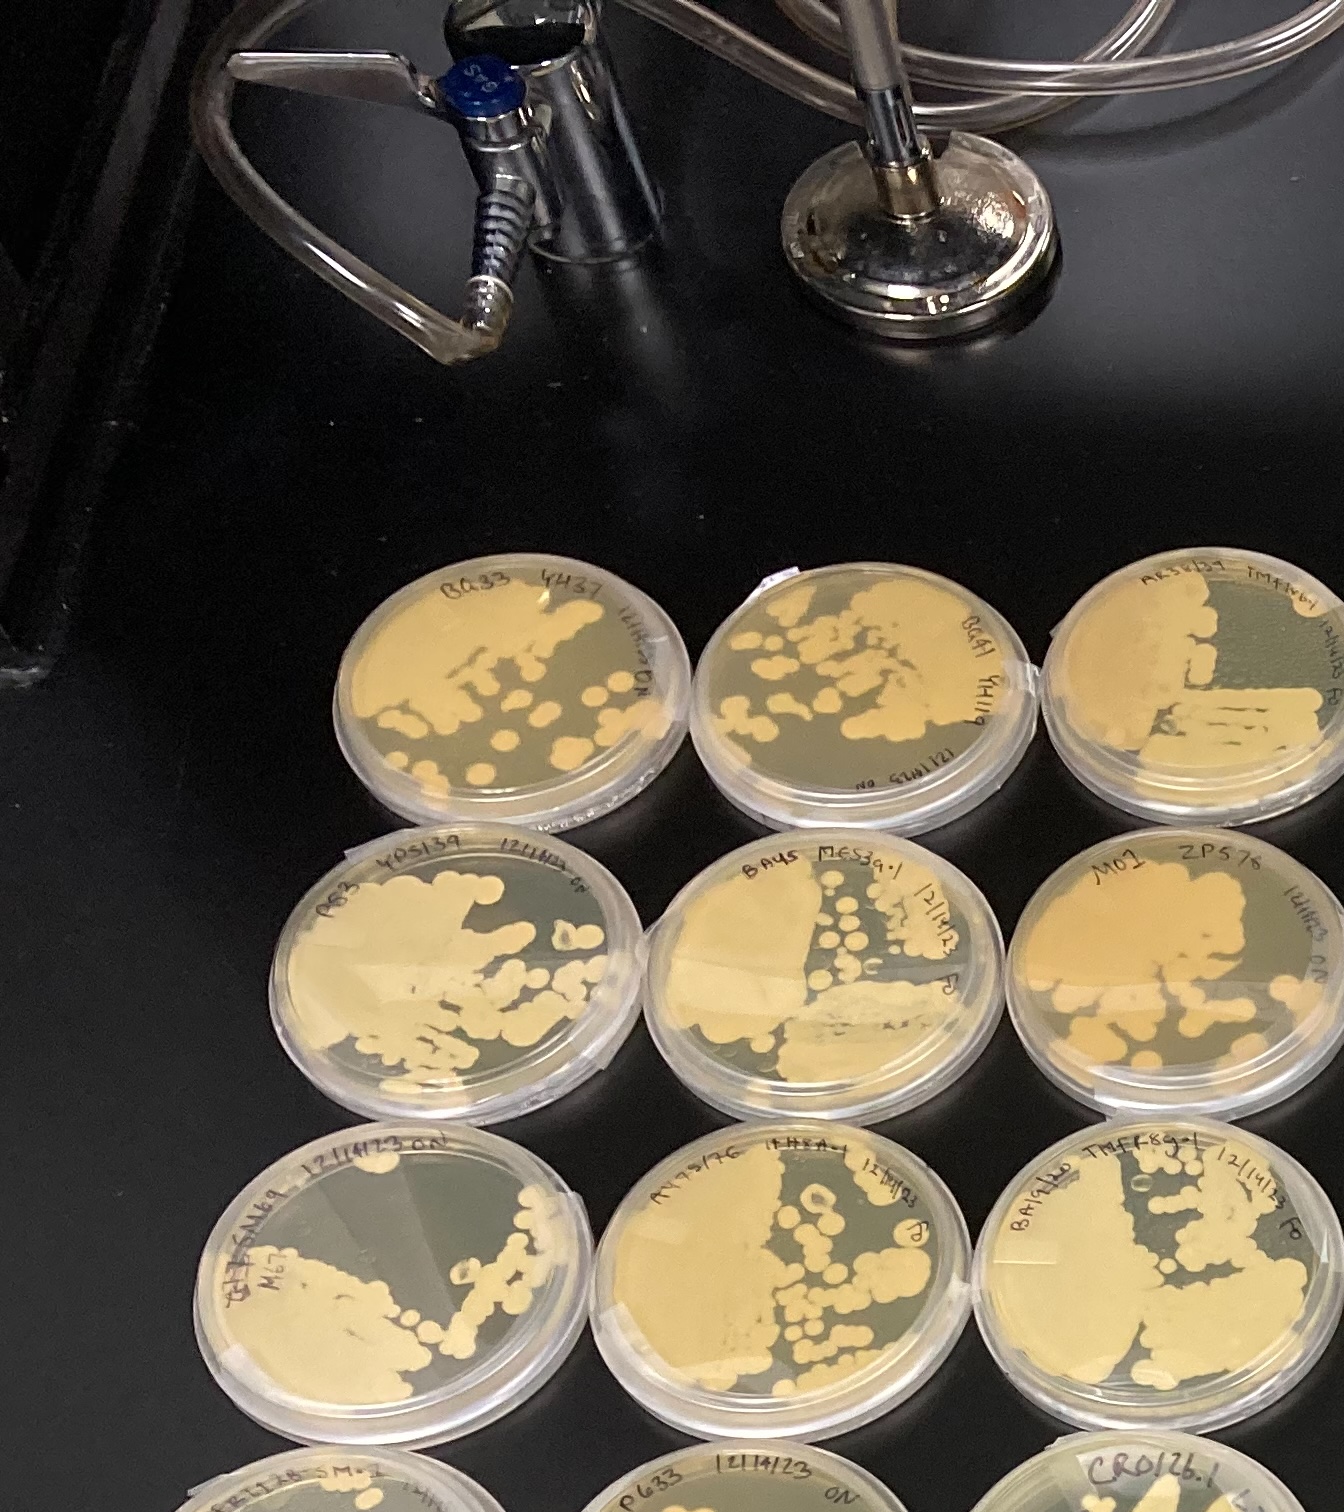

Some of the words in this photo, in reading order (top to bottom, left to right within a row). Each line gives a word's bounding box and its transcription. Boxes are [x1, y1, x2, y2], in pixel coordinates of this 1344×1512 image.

[907, 881, 975, 957] 12/14/23
[1213, 1144, 1297, 1209] 12/14/23
[715, 1449, 816, 1487] 12/14/23
[821, 1479, 860, 1511] ON
